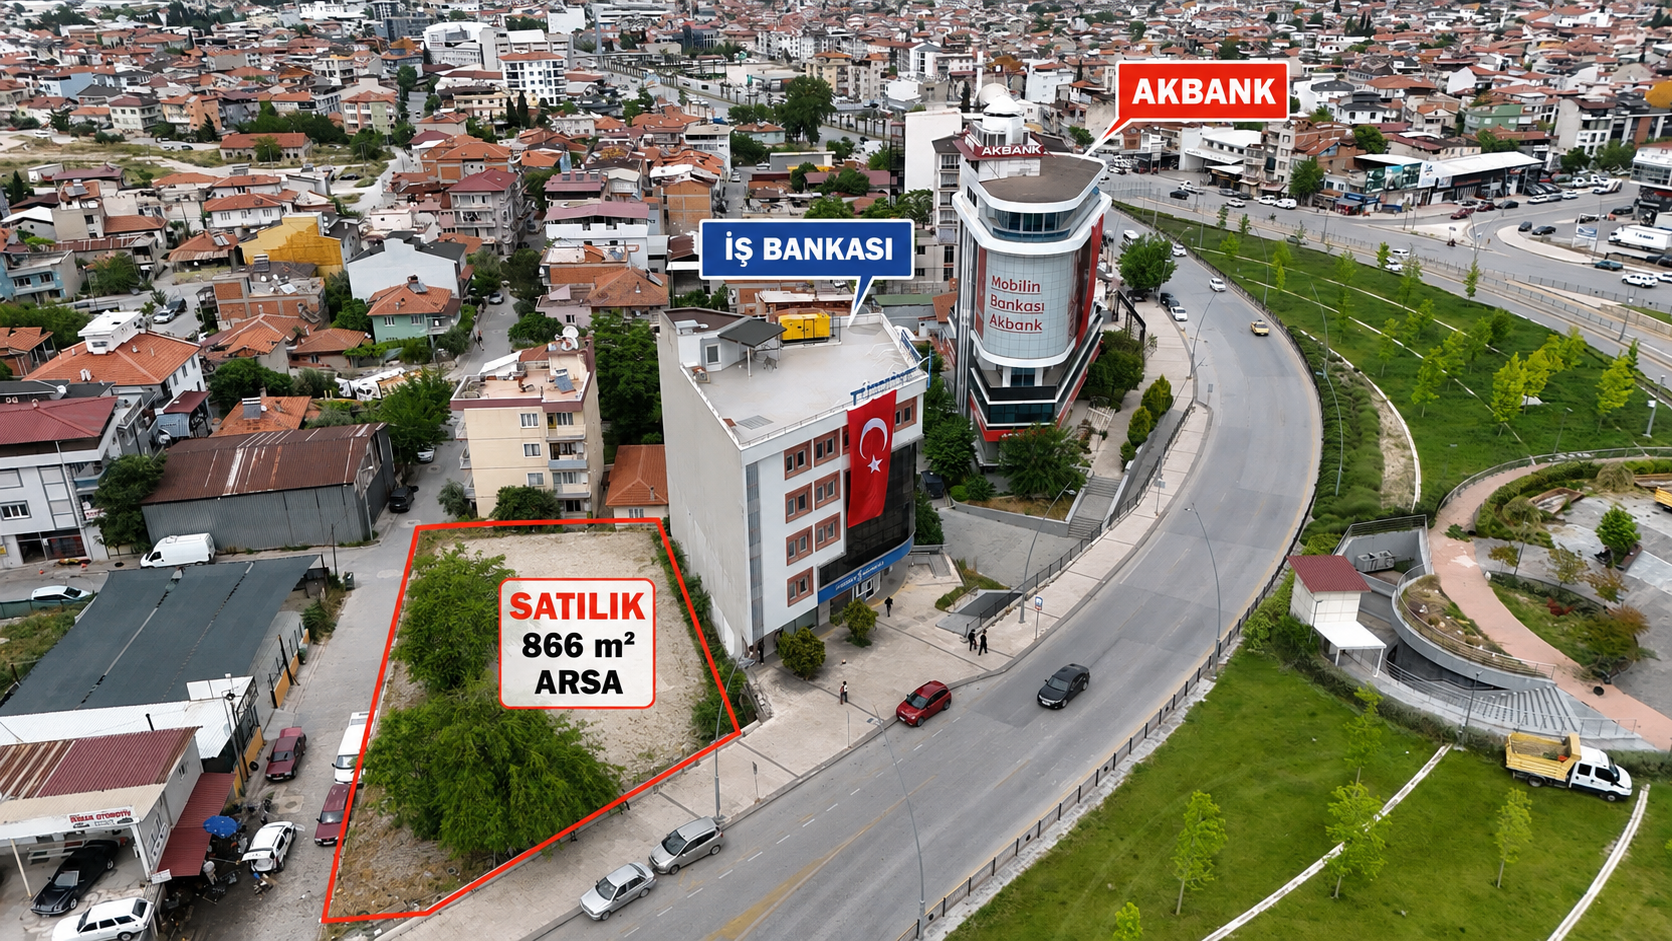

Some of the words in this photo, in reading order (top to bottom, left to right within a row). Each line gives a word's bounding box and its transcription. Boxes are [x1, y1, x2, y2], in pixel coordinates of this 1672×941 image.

[981, 145, 1042, 156] AKBANK
[991, 275, 1041, 293] Mobilin
[990, 293, 1045, 312] Bankası
[989, 313, 1043, 331] Akbank
